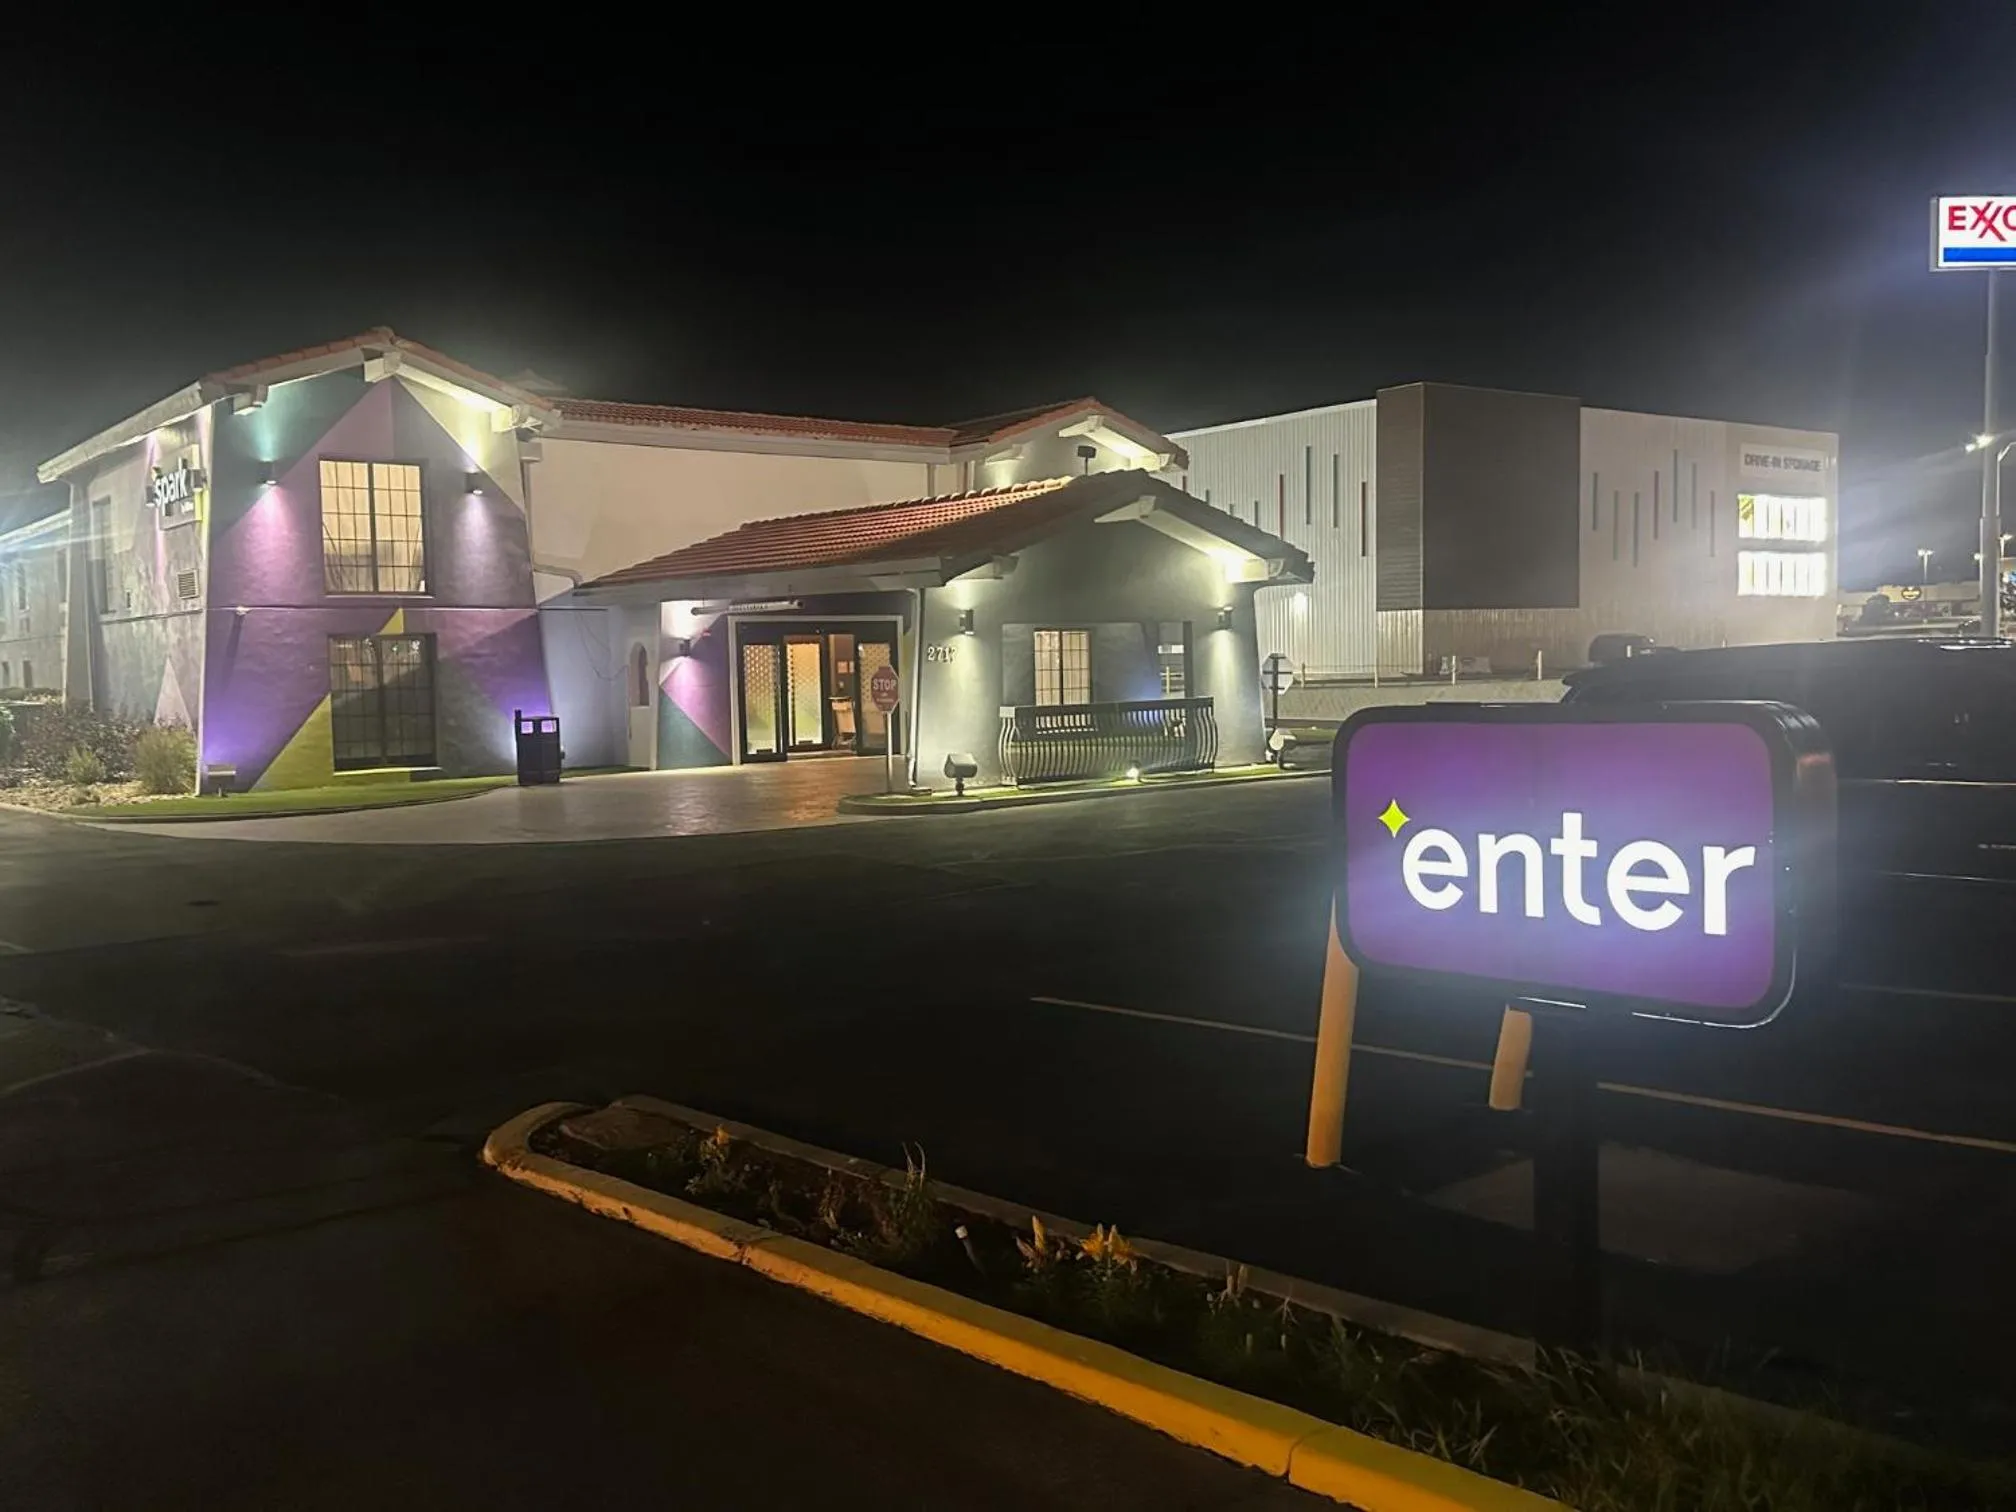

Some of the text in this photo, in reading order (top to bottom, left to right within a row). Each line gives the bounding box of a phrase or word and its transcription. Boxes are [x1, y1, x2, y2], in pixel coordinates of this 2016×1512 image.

[1743, 453, 1822, 472] DRIVE-IN STORAGE
[154, 457, 188, 516] spark
[873, 678, 897, 691] STOP
[1402, 812, 1756, 936] enter
